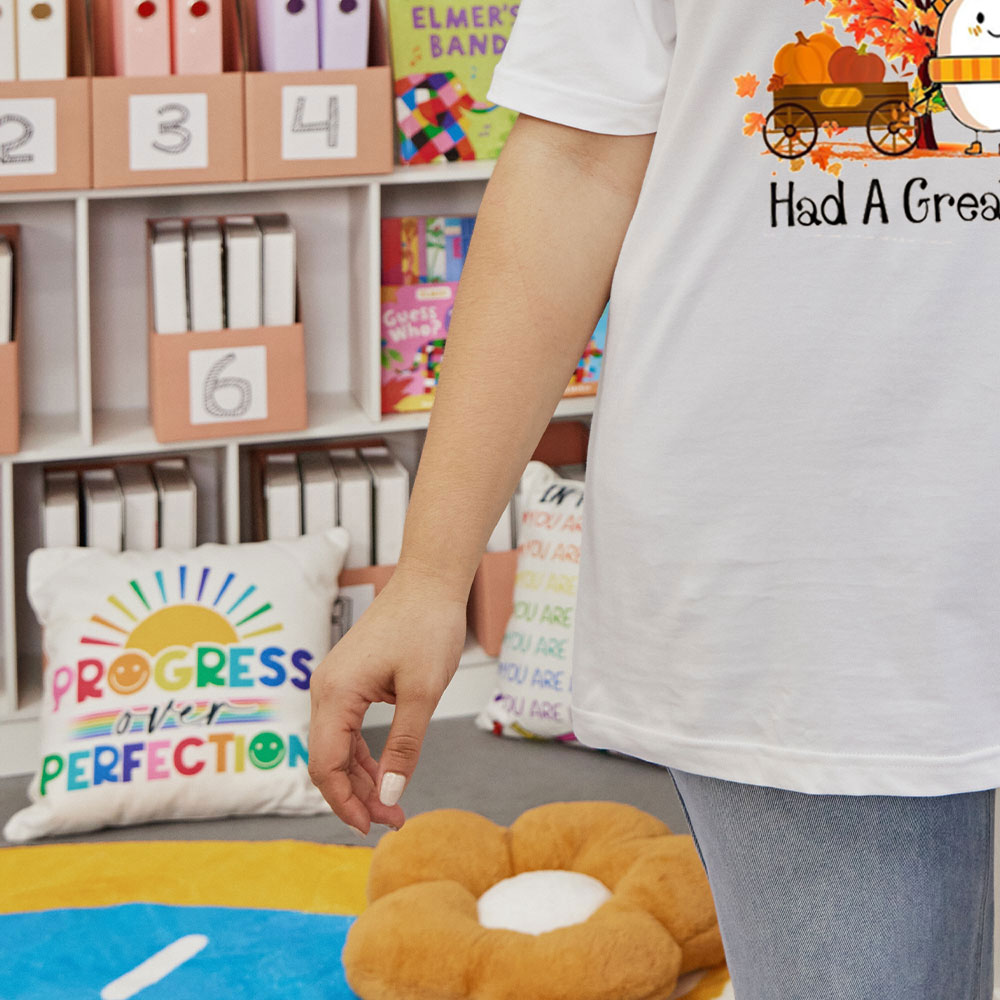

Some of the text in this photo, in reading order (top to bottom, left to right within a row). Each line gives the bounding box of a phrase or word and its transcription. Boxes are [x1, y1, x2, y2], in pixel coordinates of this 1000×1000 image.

[429, 34, 507, 58] BAND
[152, 103, 192, 155] 3
[291, 96, 339, 148] 4
[769, 179, 846, 227] Had
[863, 179, 889, 225] A
[383, 306, 437, 328] Guess
[204, 354, 252, 417] 6
